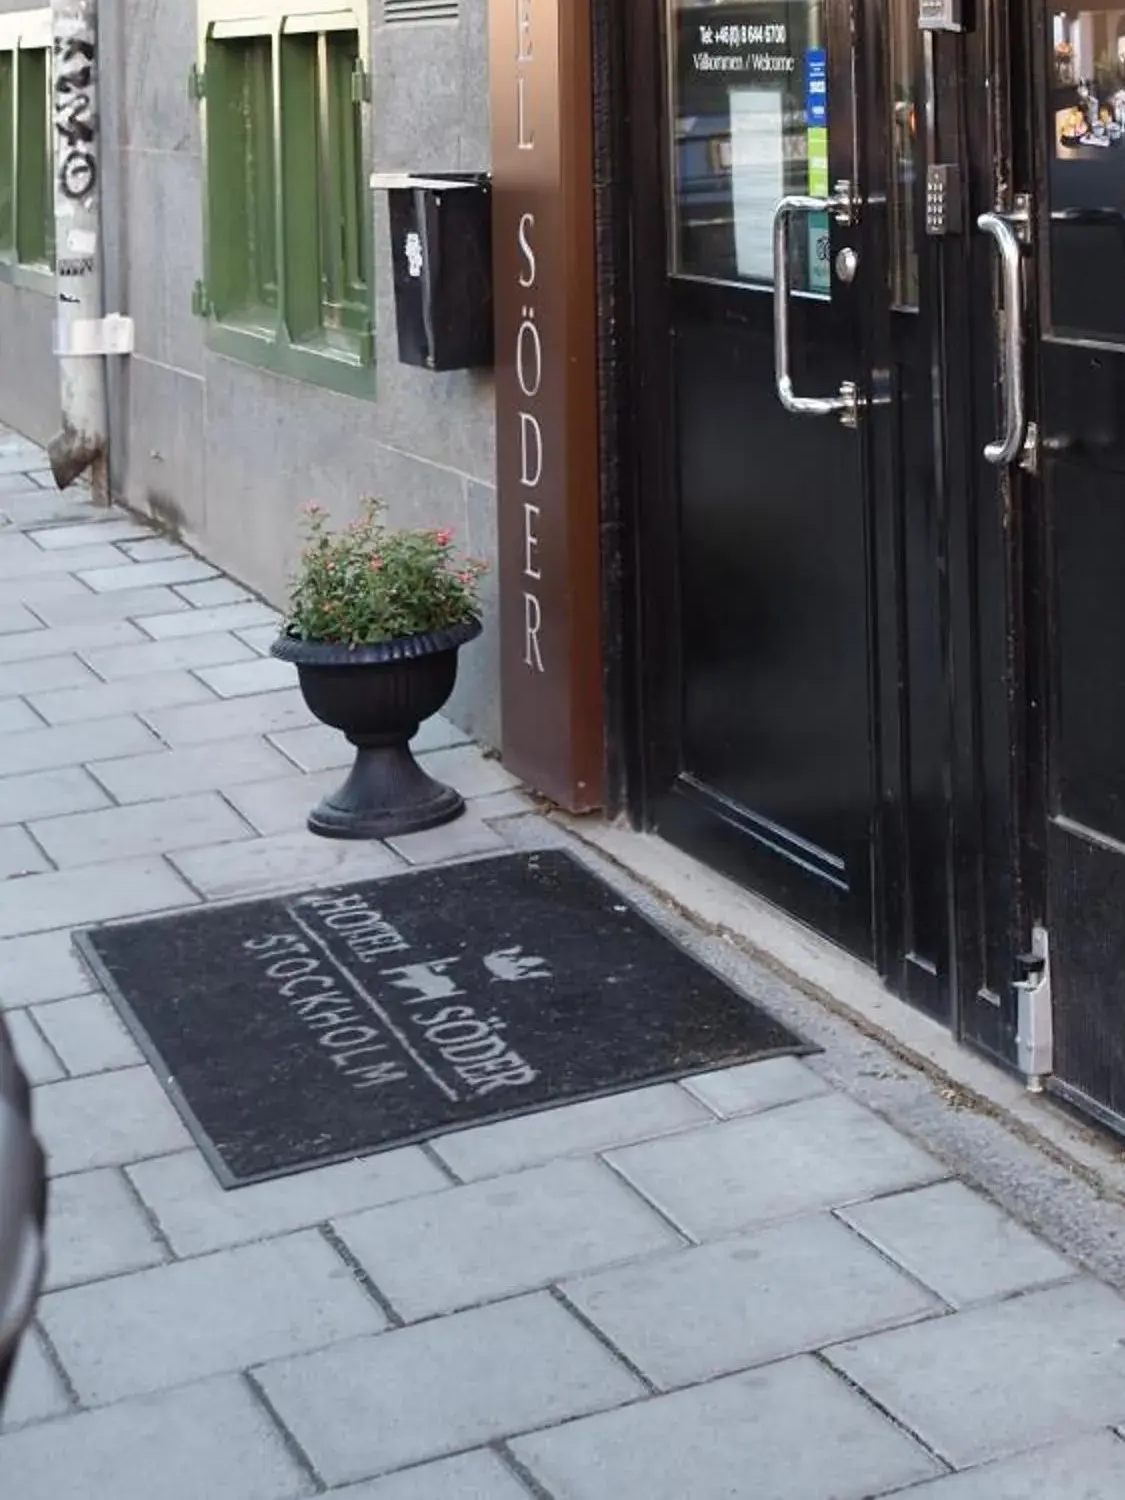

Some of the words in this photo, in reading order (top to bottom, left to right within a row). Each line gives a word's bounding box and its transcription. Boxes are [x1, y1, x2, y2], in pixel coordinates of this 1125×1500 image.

[517, 212, 544, 672] SÖDER
[242, 933, 408, 1089] STOCKHOLM
[304, 894, 411, 963] HOTEL
[411, 1005, 541, 1097] SÖDER
